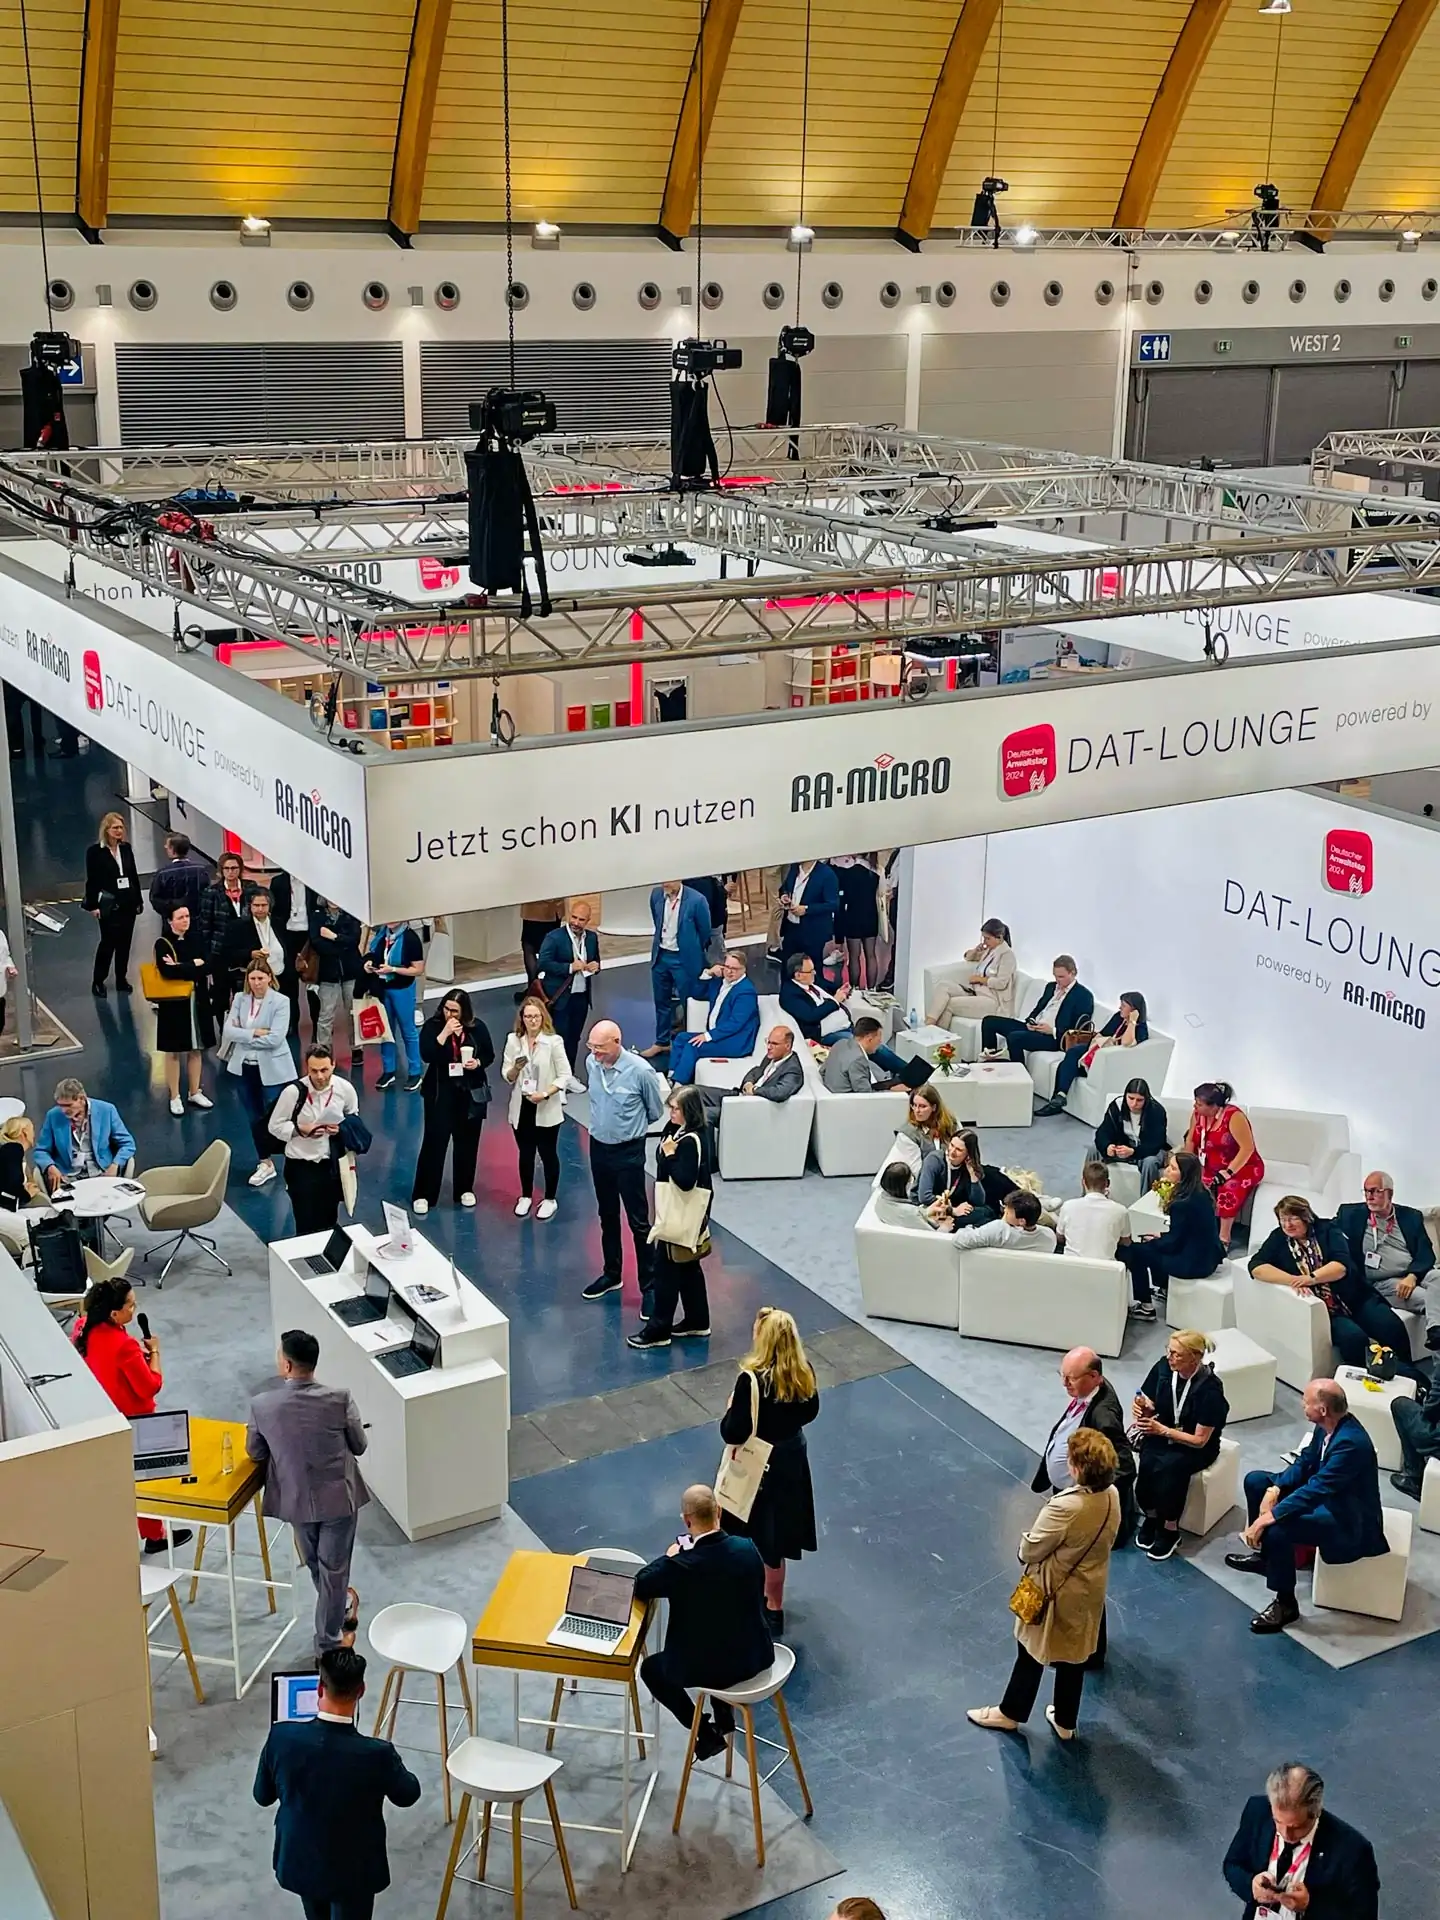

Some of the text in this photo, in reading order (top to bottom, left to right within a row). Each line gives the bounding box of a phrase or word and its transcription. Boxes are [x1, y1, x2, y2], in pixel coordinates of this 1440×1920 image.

[1290, 334, 1341, 352] WEST 2
[105, 674, 207, 767] DAT-LOUNGE
[214, 750, 251, 785] powered
[253, 769, 265, 798] by
[1068, 699, 1432, 773] DAT-LOUNGE powered by
[1006, 770, 1024, 780] 2024
[406, 825, 489, 864] Jetzt
[501, 815, 597, 851] schon
[610, 804, 641, 836] KI
[654, 797, 755, 830] nutzen
[1328, 864, 1345, 876] 2024
[1256, 954, 1311, 984] powered
[1315, 974, 1332, 994] by
